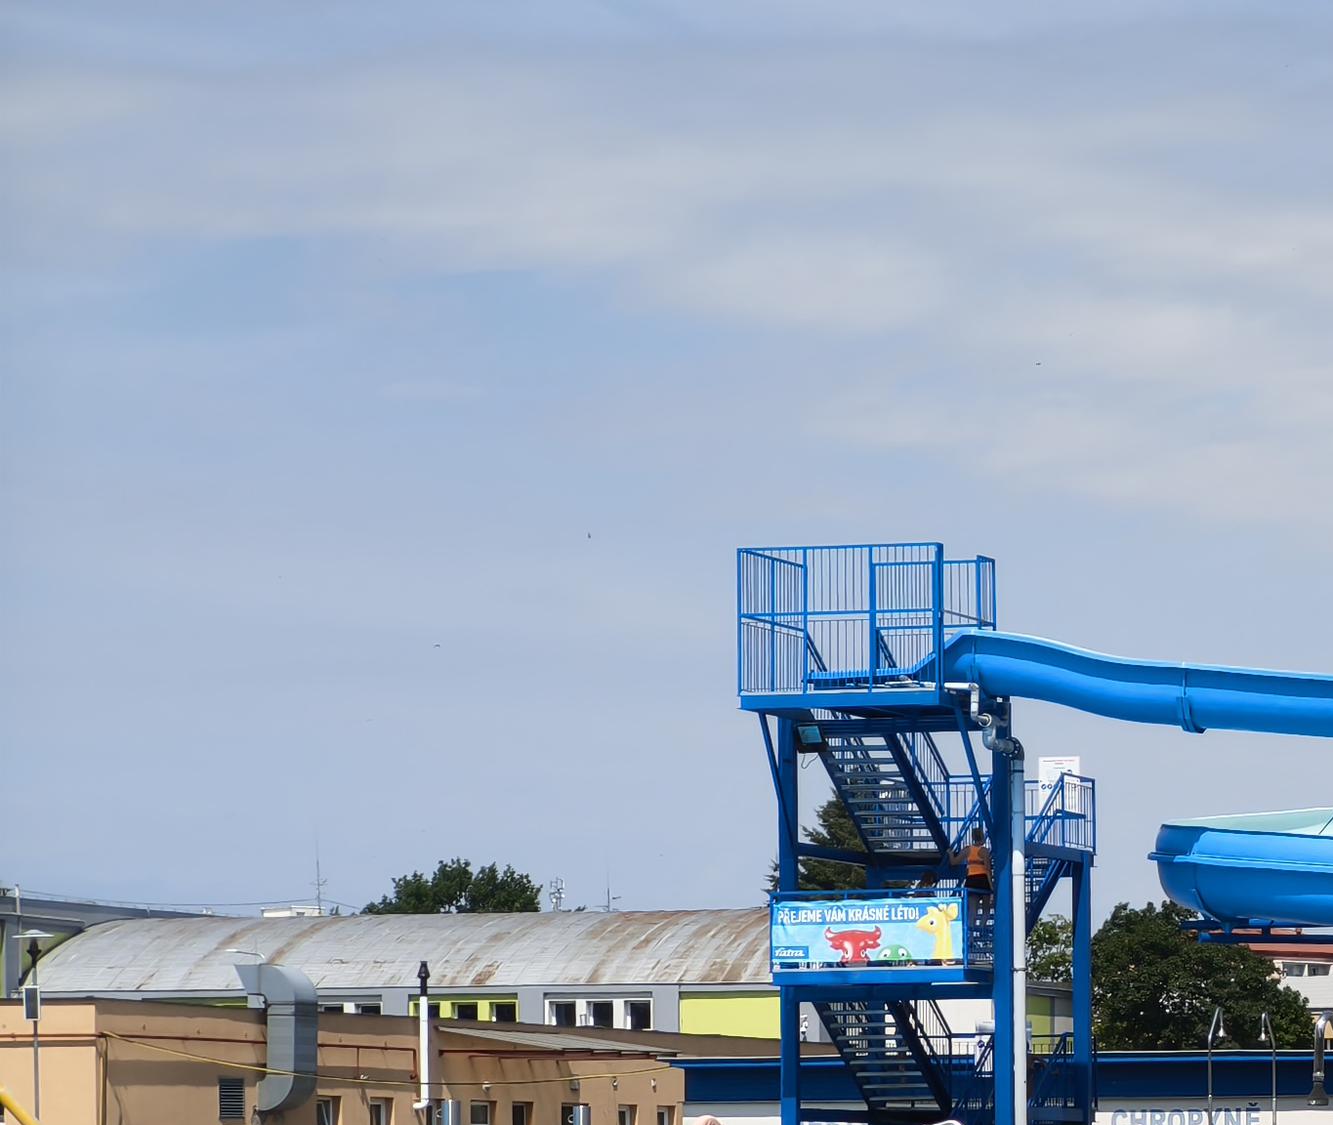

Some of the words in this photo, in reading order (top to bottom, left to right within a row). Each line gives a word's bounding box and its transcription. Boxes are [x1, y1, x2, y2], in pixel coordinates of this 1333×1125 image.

[779, 907, 823, 924] PŘEJEME
[824, 905, 846, 922] VÁM
[848, 905, 888, 921] KRÁSNÉ
[891, 904, 919, 920] LÉTO!
